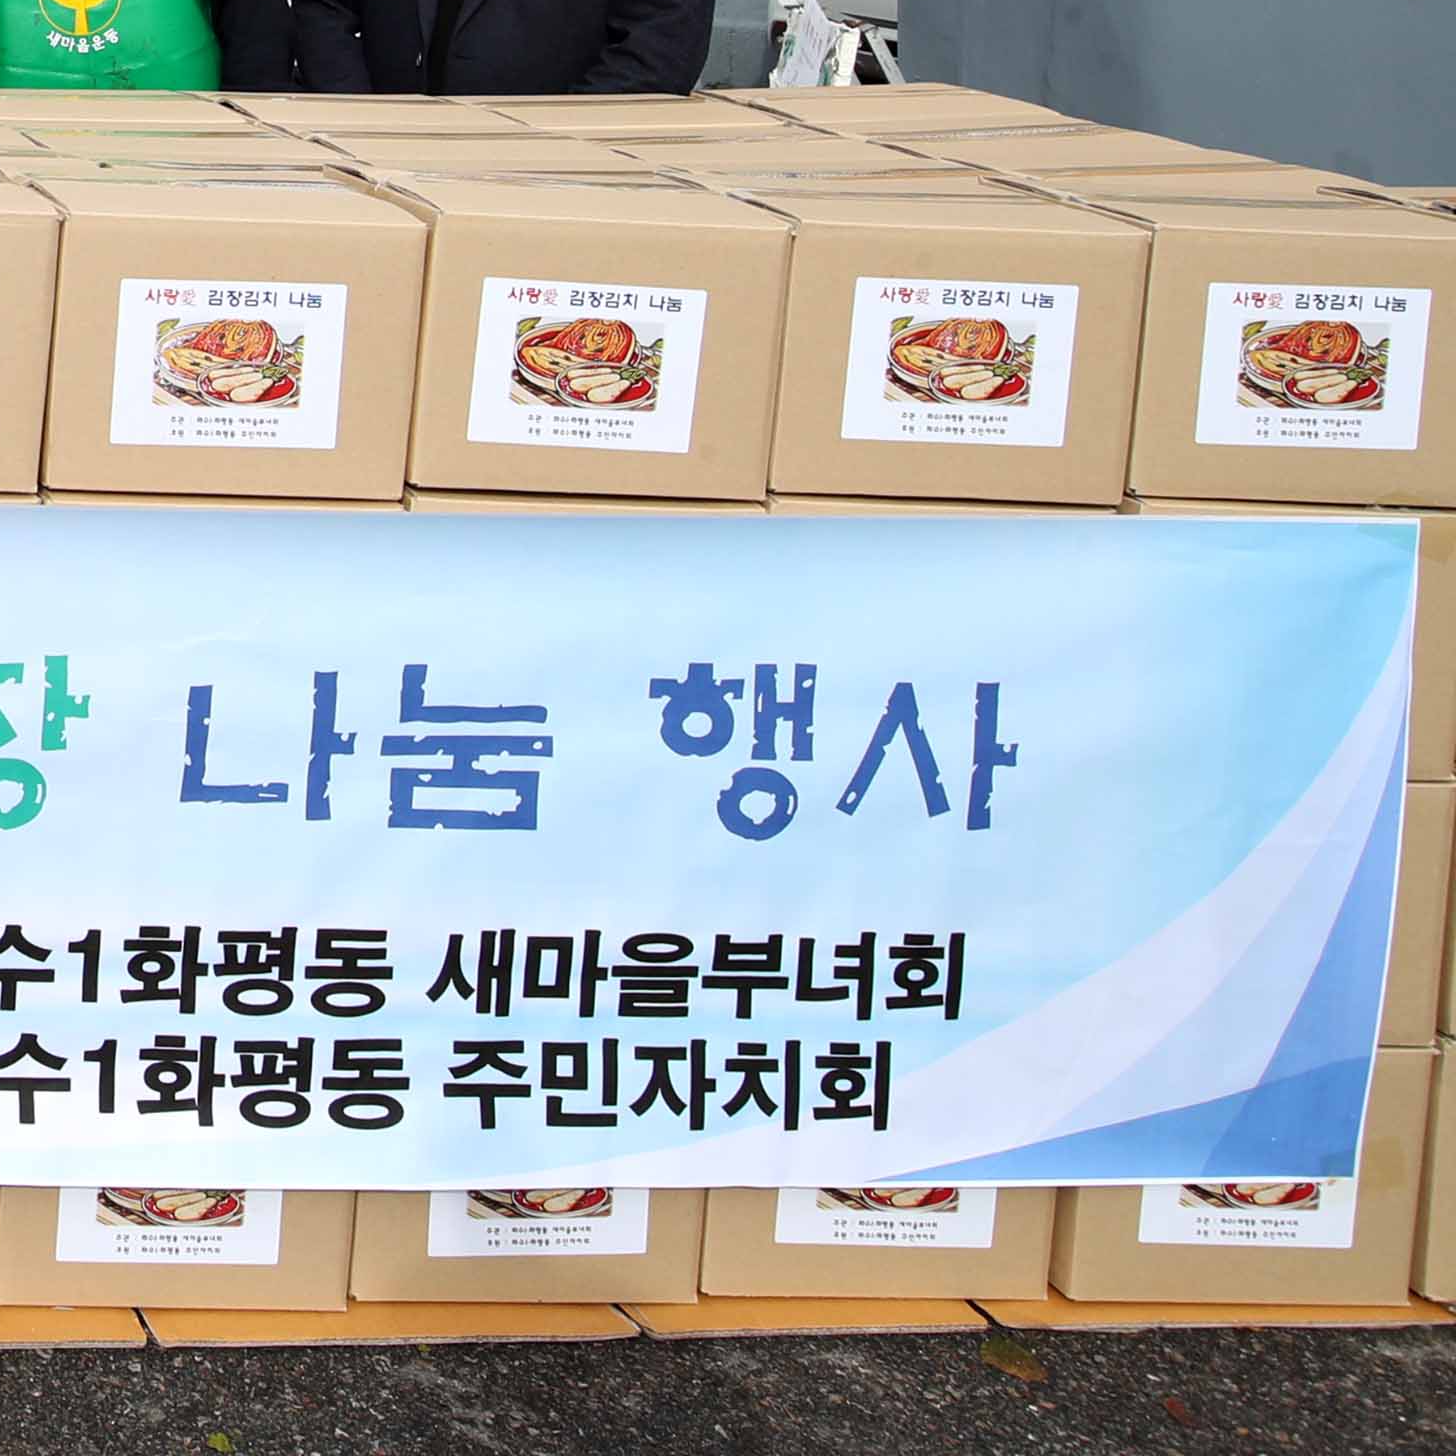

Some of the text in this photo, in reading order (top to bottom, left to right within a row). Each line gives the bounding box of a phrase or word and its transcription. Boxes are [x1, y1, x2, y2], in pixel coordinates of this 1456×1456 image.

[46, 28, 119, 54] 새마을운동
[209, 290, 277, 307] 김장김치
[289, 292, 322, 308] 나눔
[570, 290, 638, 309] 김장김치
[649, 296, 682, 312] 나눔
[943, 289, 1010, 307] 김장김치
[1022, 293, 1054, 308] 나눔
[1296, 294, 1362, 310] 김장김치
[1375, 296, 1406, 312] 나눔
[180, 664, 553, 830] 나눔
[649, 663, 1018, 841] 행사
[426, 929, 965, 1021] 새마을부녀회
[443, 1038, 891, 1131] 주민자치회
